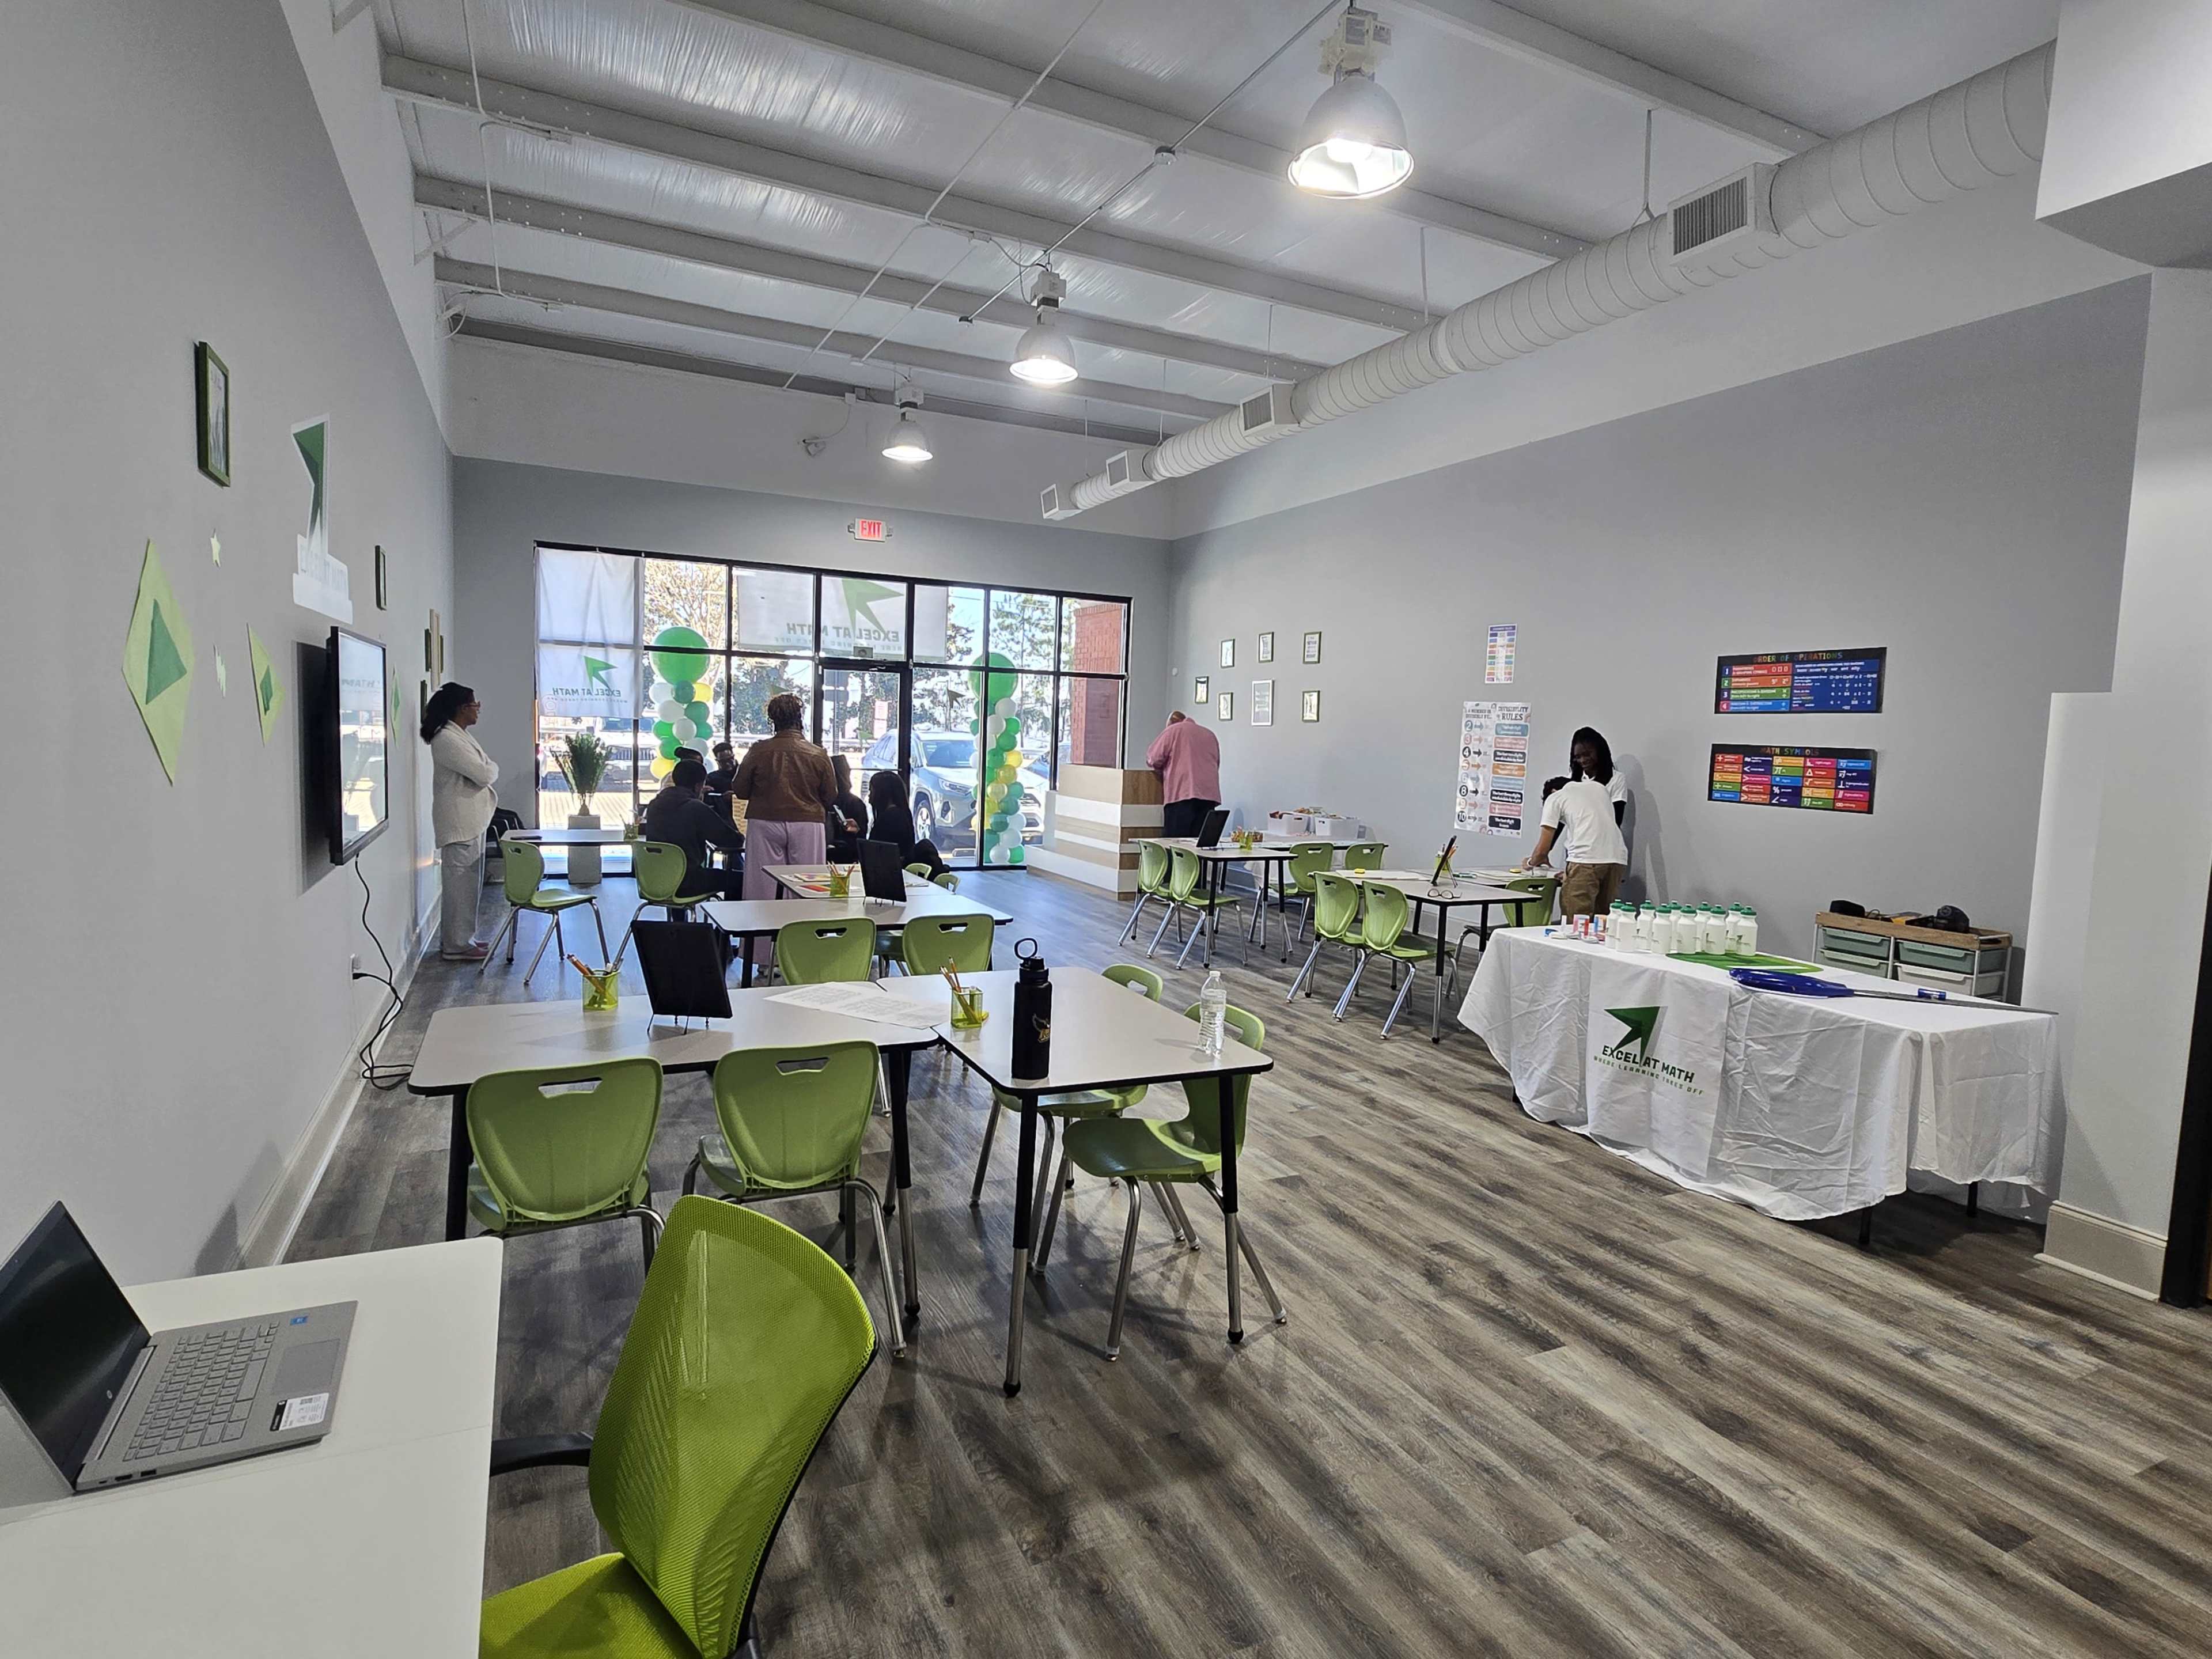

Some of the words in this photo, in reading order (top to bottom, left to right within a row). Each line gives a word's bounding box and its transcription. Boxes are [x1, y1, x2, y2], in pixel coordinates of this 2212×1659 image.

[861, 520, 882, 537] EXIT
[1794, 652, 1843, 661] OPERATIONS
[1458, 812, 1465, 821] 10
[1602, 1045, 1639, 1065] EXCEL
[1642, 1056, 1660, 1070] AT
[1661, 1062, 1695, 1083] MATH
[1618, 1065, 1660, 1079] LEARNING
[1686, 1086, 1705, 1096] OFF
